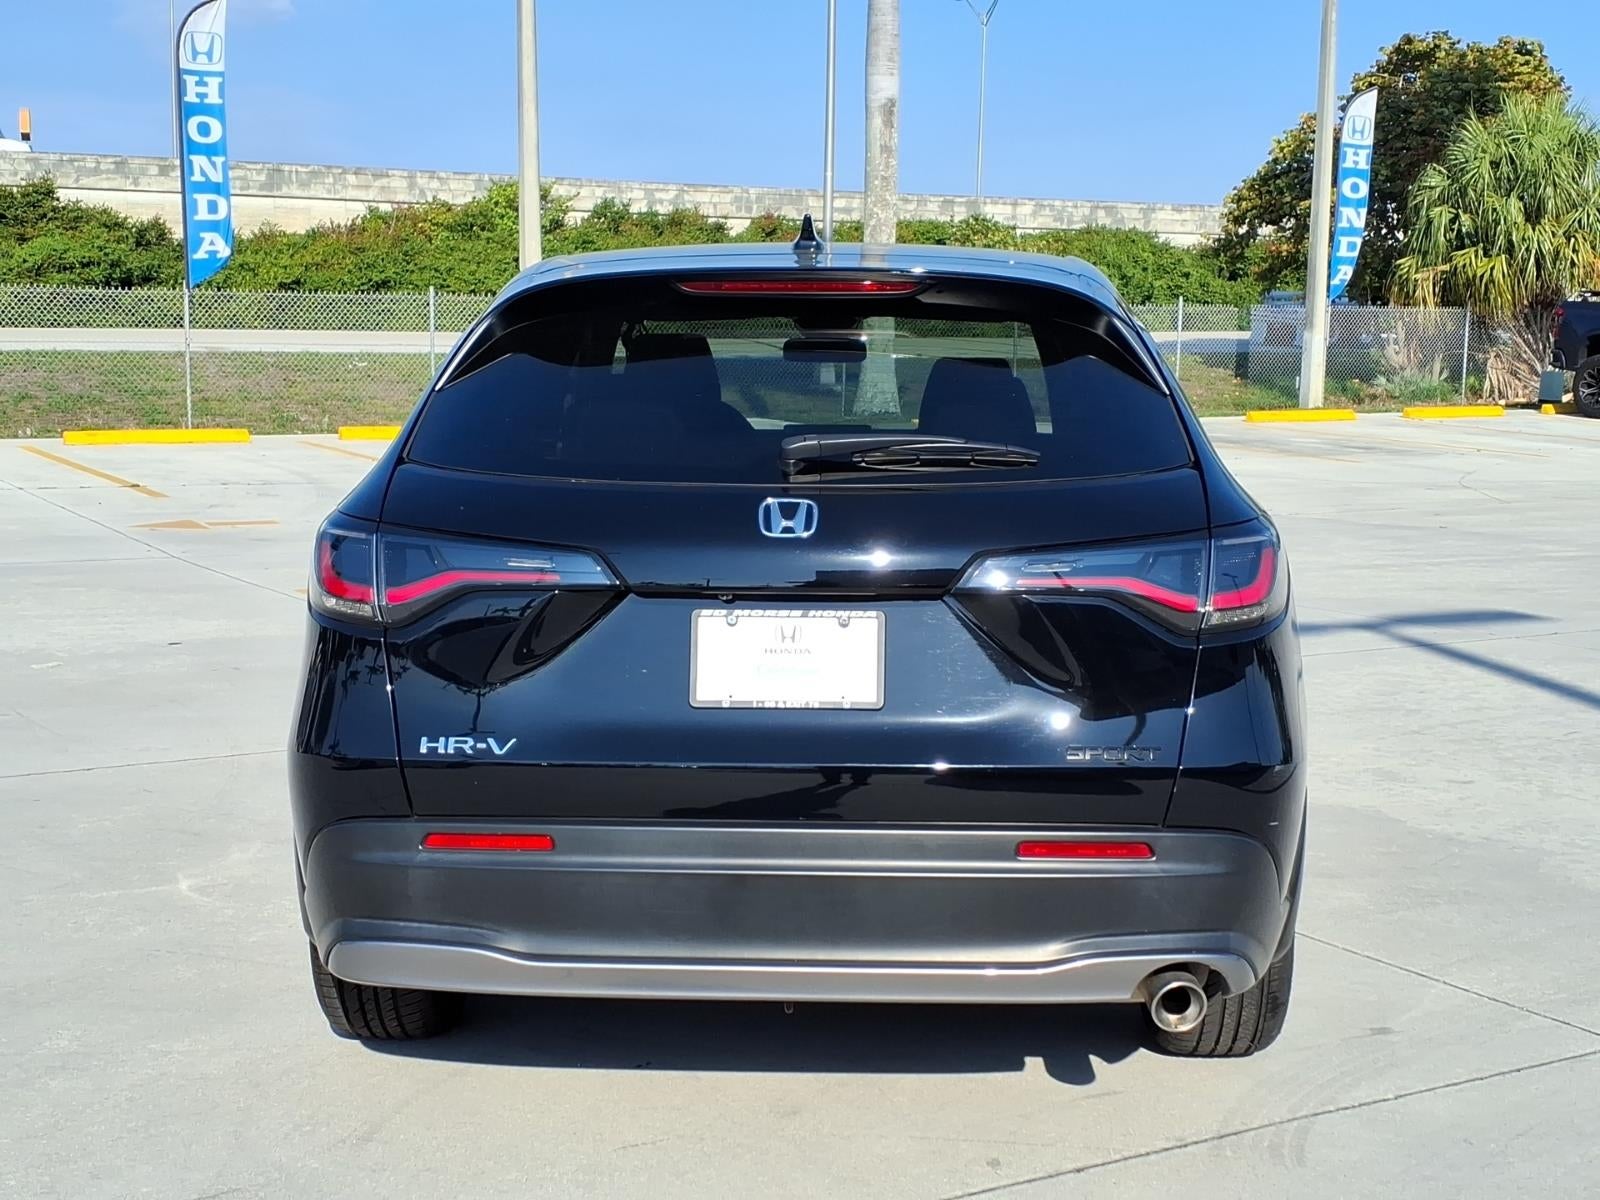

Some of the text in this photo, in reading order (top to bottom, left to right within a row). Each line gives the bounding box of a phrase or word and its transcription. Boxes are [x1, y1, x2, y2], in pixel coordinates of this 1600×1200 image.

[182, 74, 232, 260] HONDA
[1330, 147, 1370, 285] HONDA
[700, 609, 878, 618] ED MORSE HONDA
[763, 647, 812, 655] HONDA
[419, 736, 517, 755] HR-V
[1066, 744, 1162, 761] SPORT
